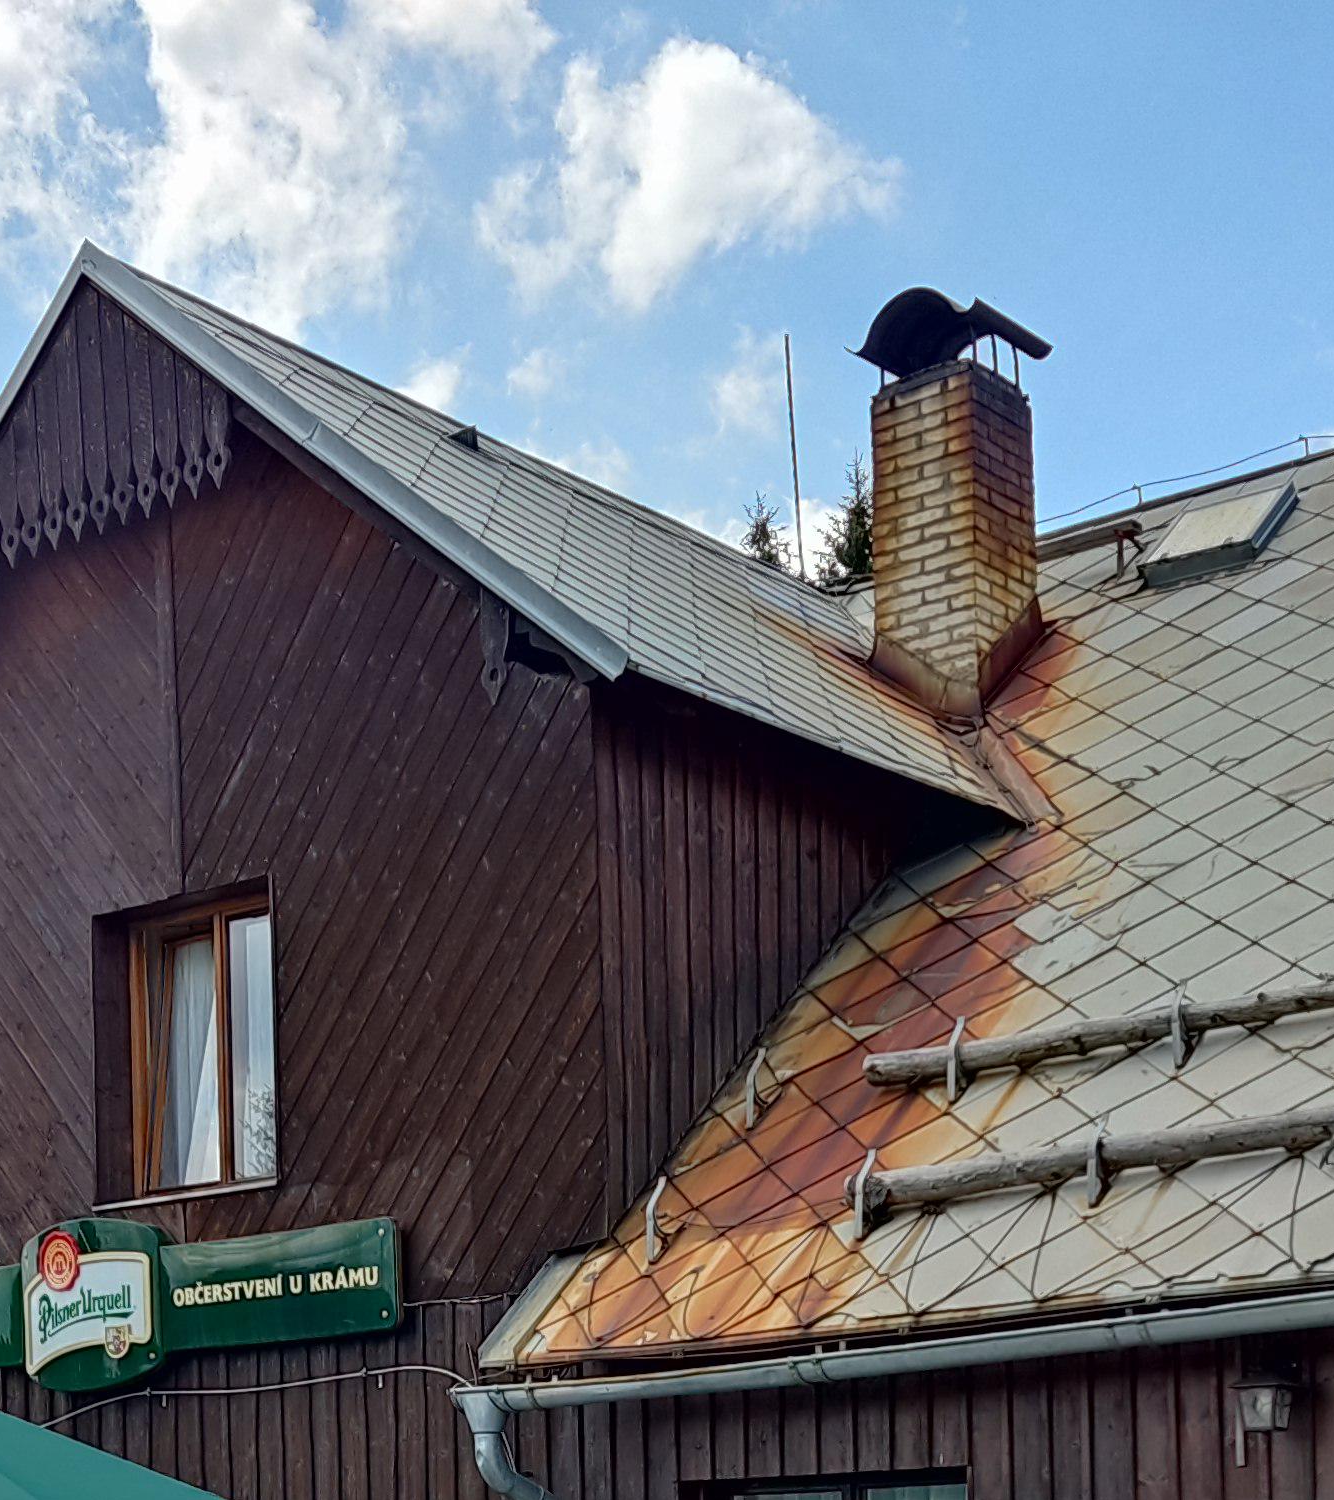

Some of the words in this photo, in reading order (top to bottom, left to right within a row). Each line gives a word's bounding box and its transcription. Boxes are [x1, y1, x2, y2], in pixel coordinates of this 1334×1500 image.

[172, 1274, 283, 1307] OBČERSTVENÍ
[289, 1275, 303, 1295] U
[310, 1266, 379, 1293] KRÁMU
[38, 1294, 81, 1344] Pilsner
[80, 1284, 132, 1323] Urquell
